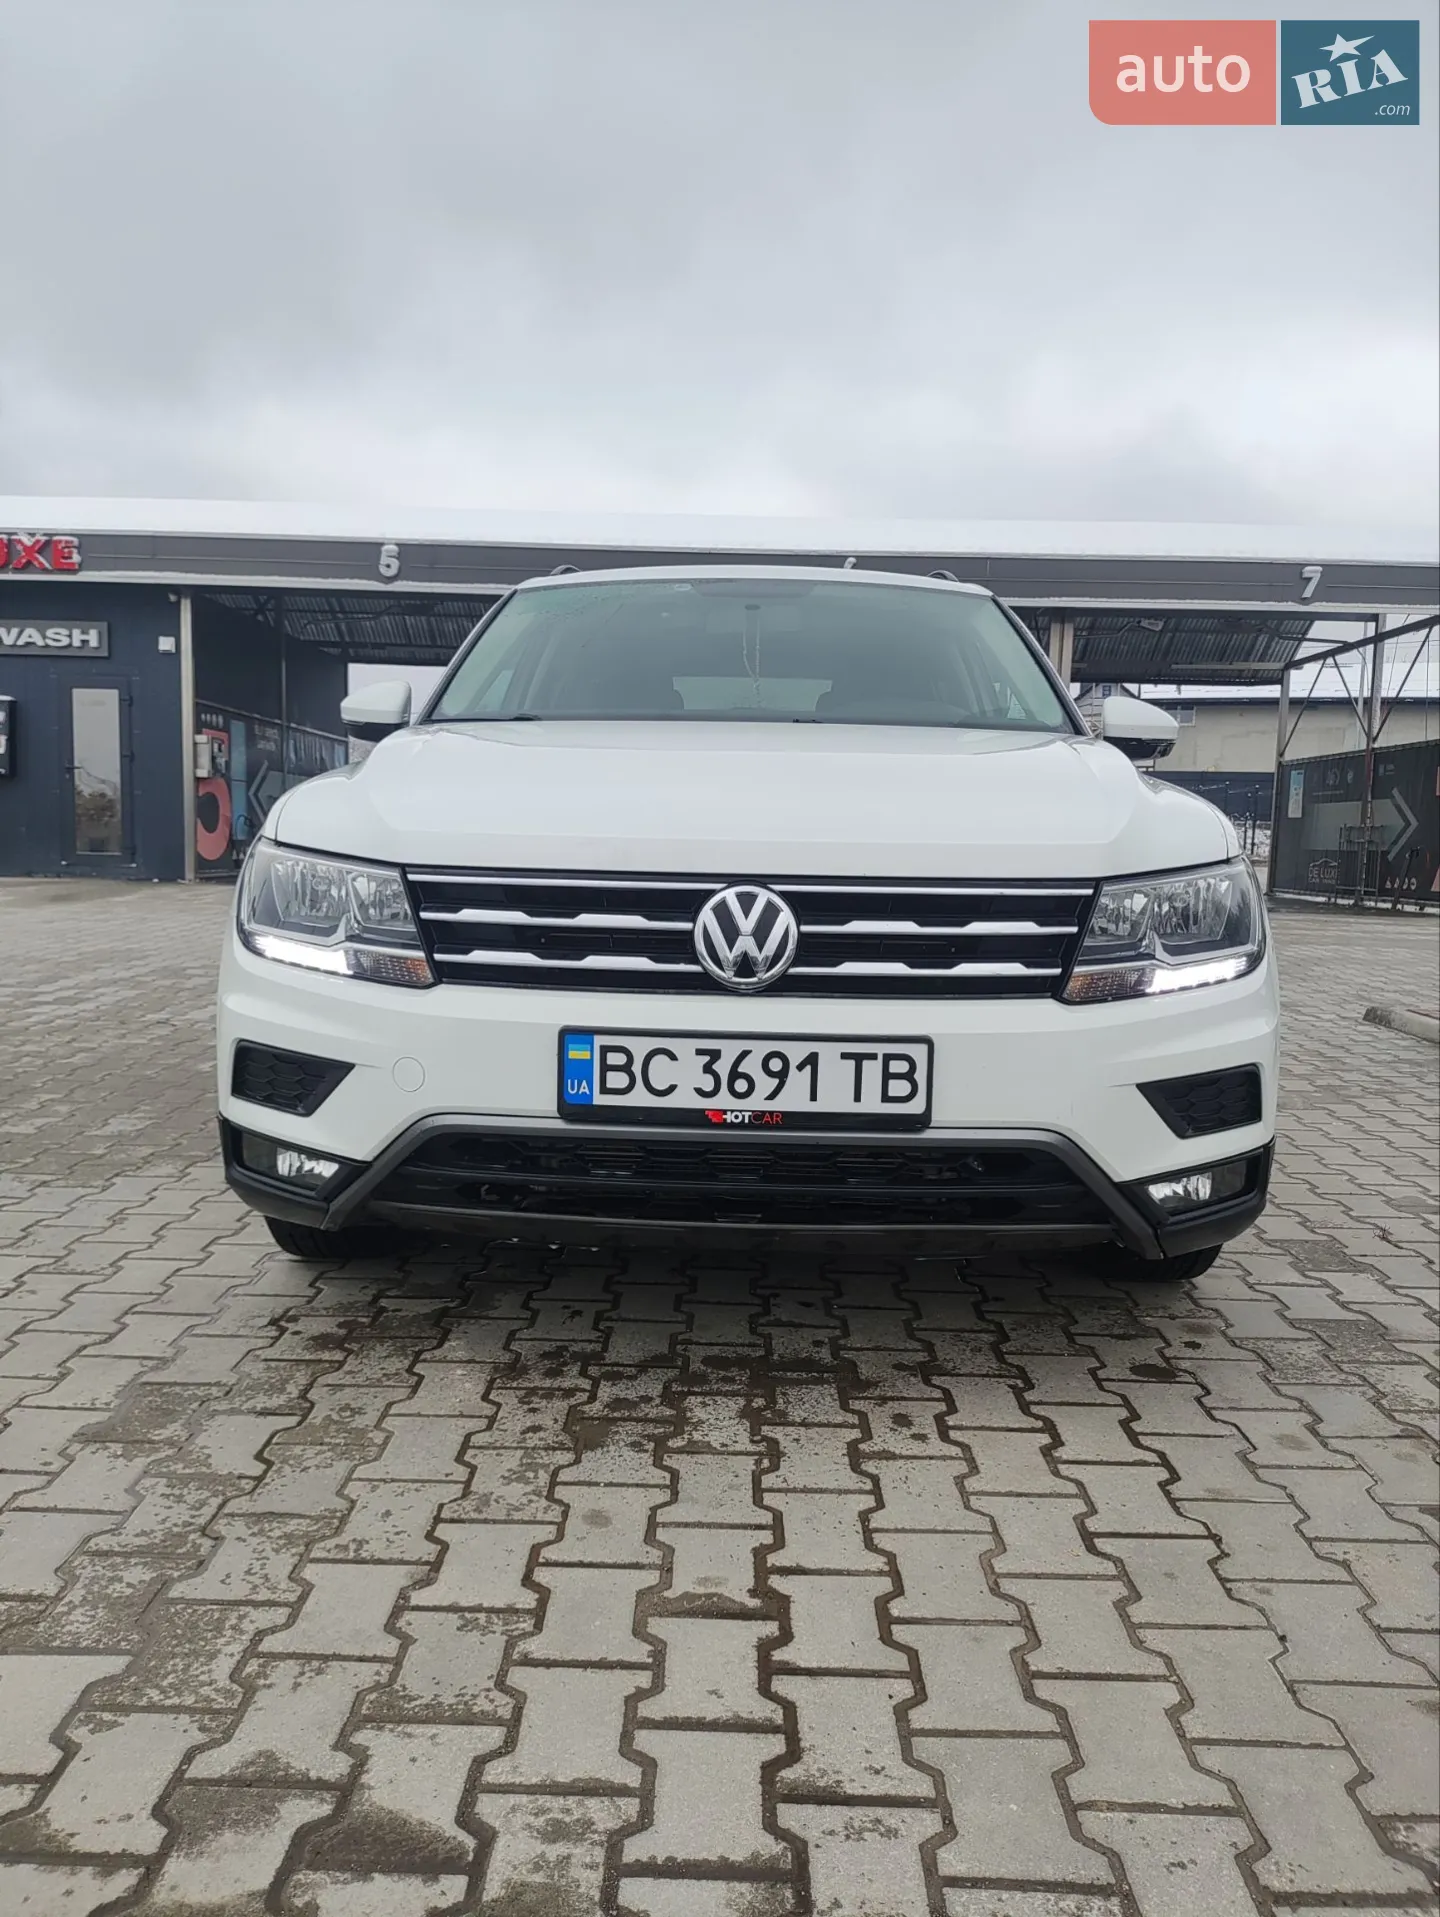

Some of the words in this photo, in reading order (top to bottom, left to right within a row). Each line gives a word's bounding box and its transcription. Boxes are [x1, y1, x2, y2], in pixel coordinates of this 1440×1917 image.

[378, 544, 401, 578] 5
[1301, 565, 1323, 599] 7
[567, 1079, 590, 1095] UA
[598, 1045, 679, 1098] BC
[693, 1048, 819, 1102] 3691
[840, 1051, 919, 1104] TB
